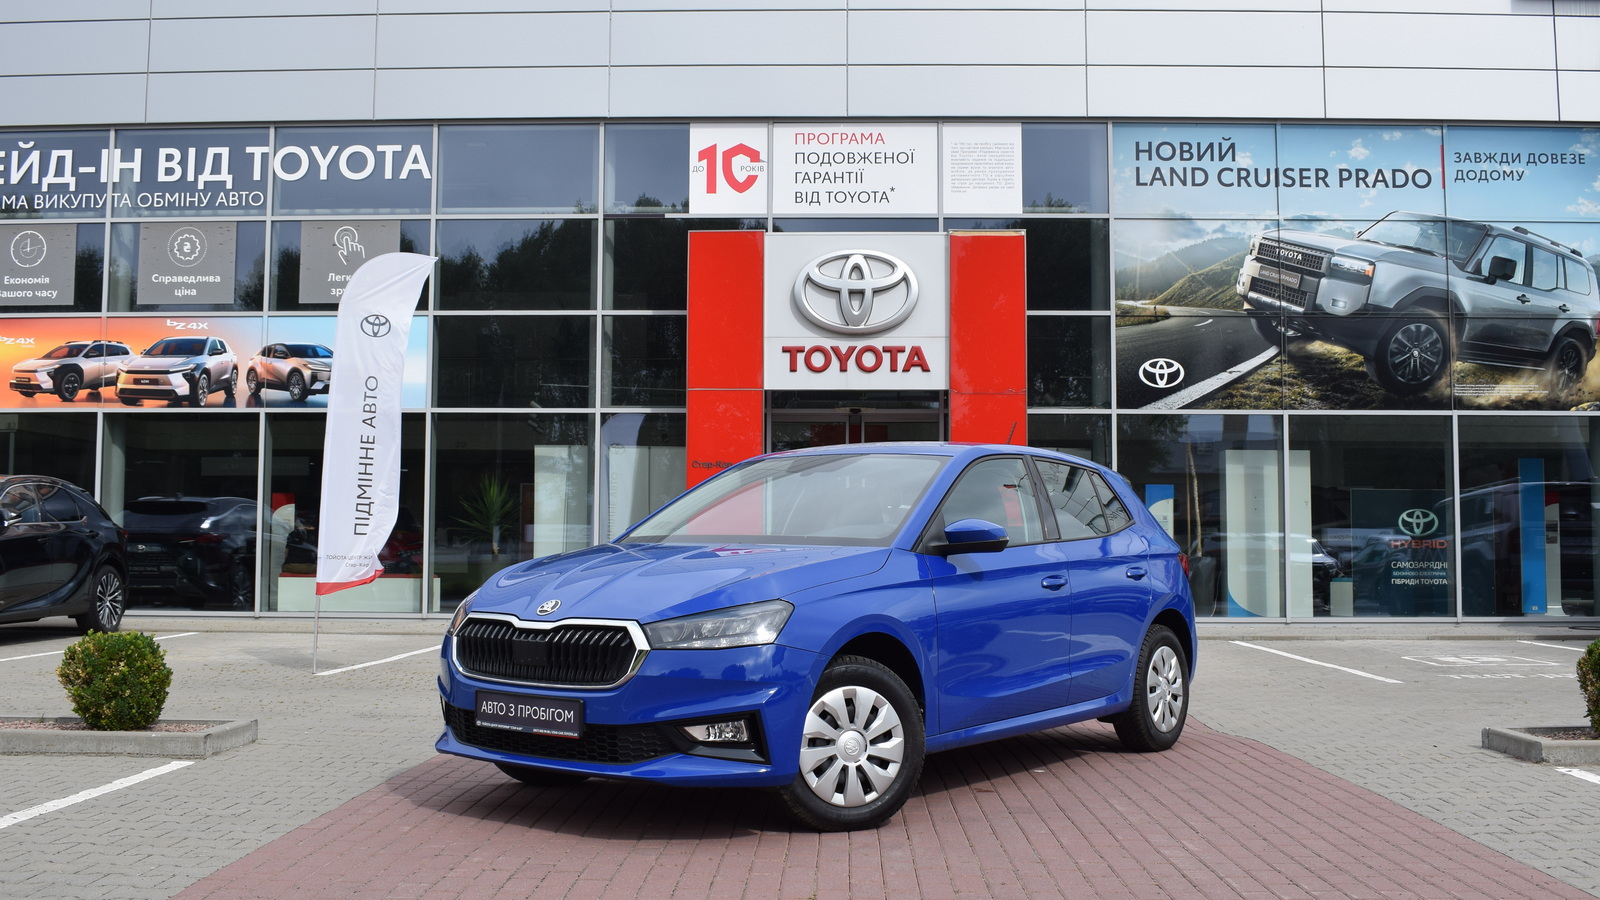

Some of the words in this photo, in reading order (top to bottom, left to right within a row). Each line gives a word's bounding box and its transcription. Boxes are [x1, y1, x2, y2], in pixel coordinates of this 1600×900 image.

[794, 132, 886, 145] ПРОГРАМА
[1135, 136, 1236, 162] НОВИЙ
[794, 148, 916, 167] ПОДОВЖЕНОЇ
[1453, 152, 1522, 166] ЗАВЖДИ
[1526, 153, 1586, 166] ДОВЕЗЕ
[157, 147, 233, 190] ВІД
[245, 144, 432, 181] TOYOTA
[692, 165, 705, 173] ДО
[794, 168, 865, 184] ГАРАНТІЇ
[1135, 166, 1209, 187] LAND
[1216, 167, 1330, 188] CRUISER
[1338, 168, 1432, 189] PRADO
[1454, 169, 1525, 183] ДОДОМУ
[0, 195, 28, 210] МА
[34, 193, 107, 209] ВИКУПУ
[112, 193, 132, 208] ТА
[137, 192, 211, 208] ОБМІНУ
[216, 191, 264, 207] АВТО
[794, 191, 822, 206] ВІД
[1275, 248, 1302, 260] TOYOTA
[4, 275, 50, 285] Економія
[152, 273, 221, 285] Справедлива
[35, 290, 58, 299] часу
[174, 286, 197, 298] ціна
[781, 345, 931, 373] TOYOTA
[361, 375, 379, 429] АВТО
[353, 434, 376, 536] ПІДМІННЕ
[1391, 539, 1448, 549] HYBRID
[1391, 561, 1448, 569] САМОЗАРЯДНІ
[481, 700, 506, 715] АВТО
[517, 705, 574, 724] ПРОБІГОМ
